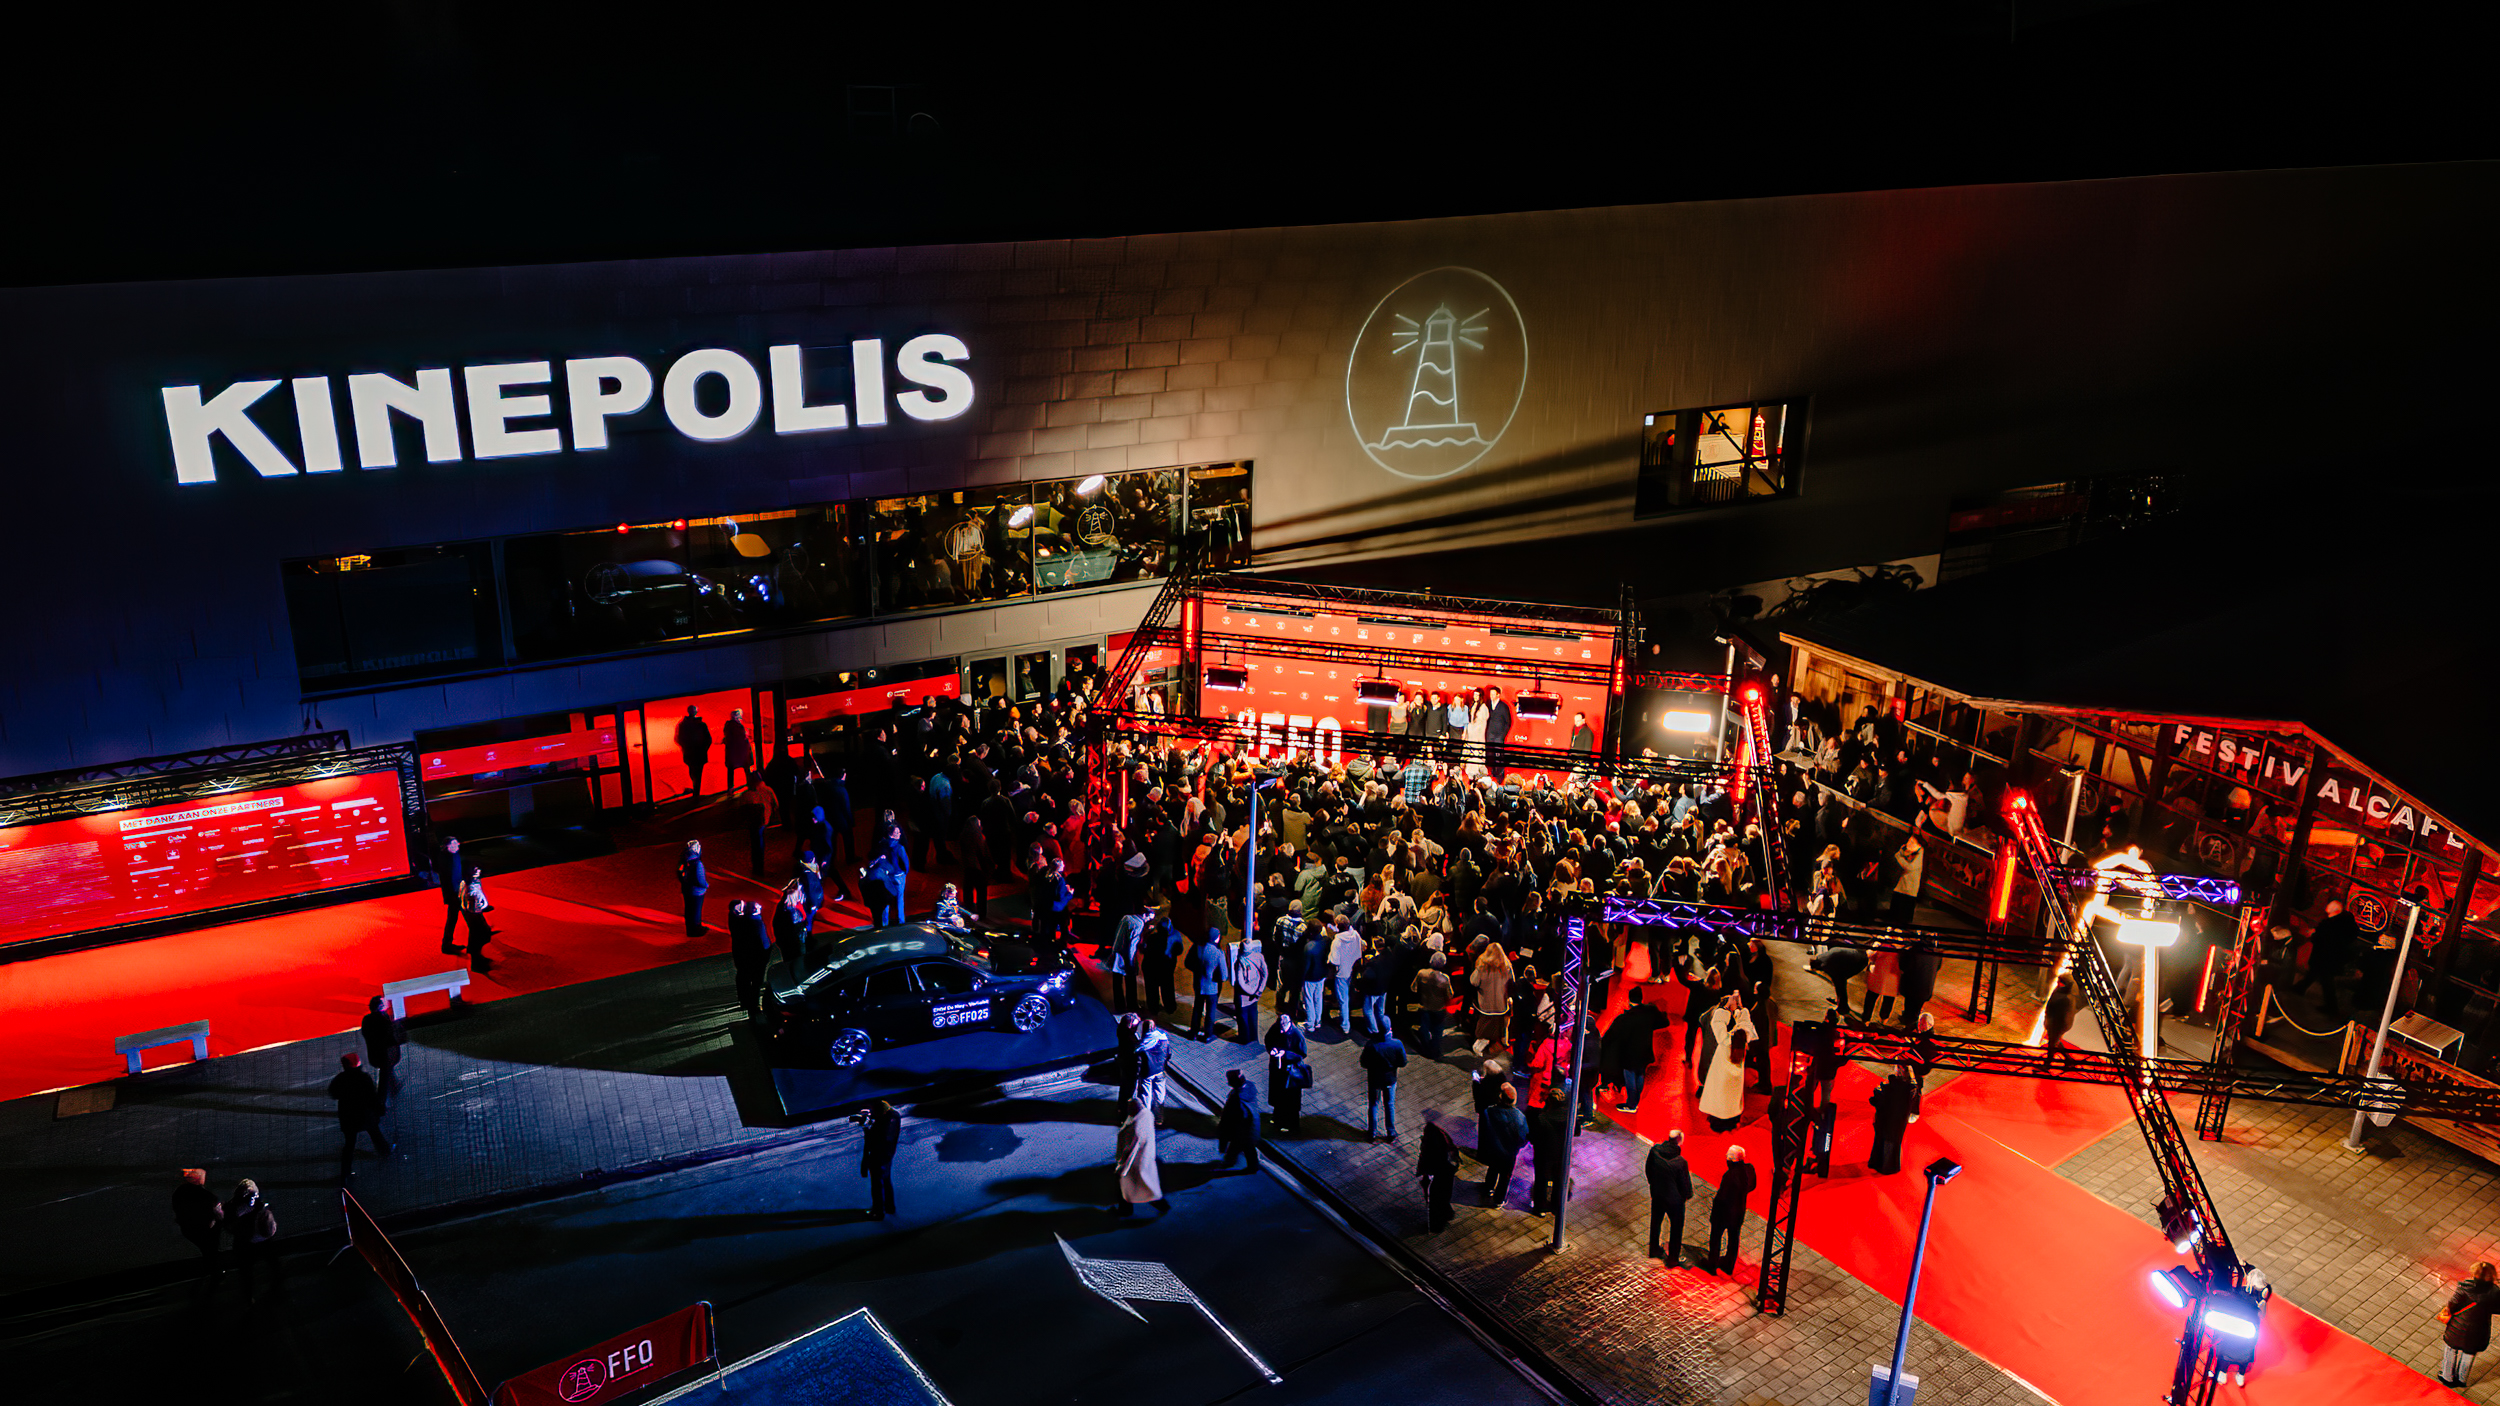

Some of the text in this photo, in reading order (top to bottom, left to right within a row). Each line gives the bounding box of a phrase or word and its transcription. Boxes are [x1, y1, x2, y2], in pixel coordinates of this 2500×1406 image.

[161, 334, 975, 484] KINEPOLIS
[122, 818, 143, 829] MET
[146, 814, 177, 826] DANK
[177, 810, 200, 820] AAN
[202, 805, 228, 817] ONZE
[230, 797, 282, 813] PARTNERS
[607, 1339, 653, 1379] FFO
